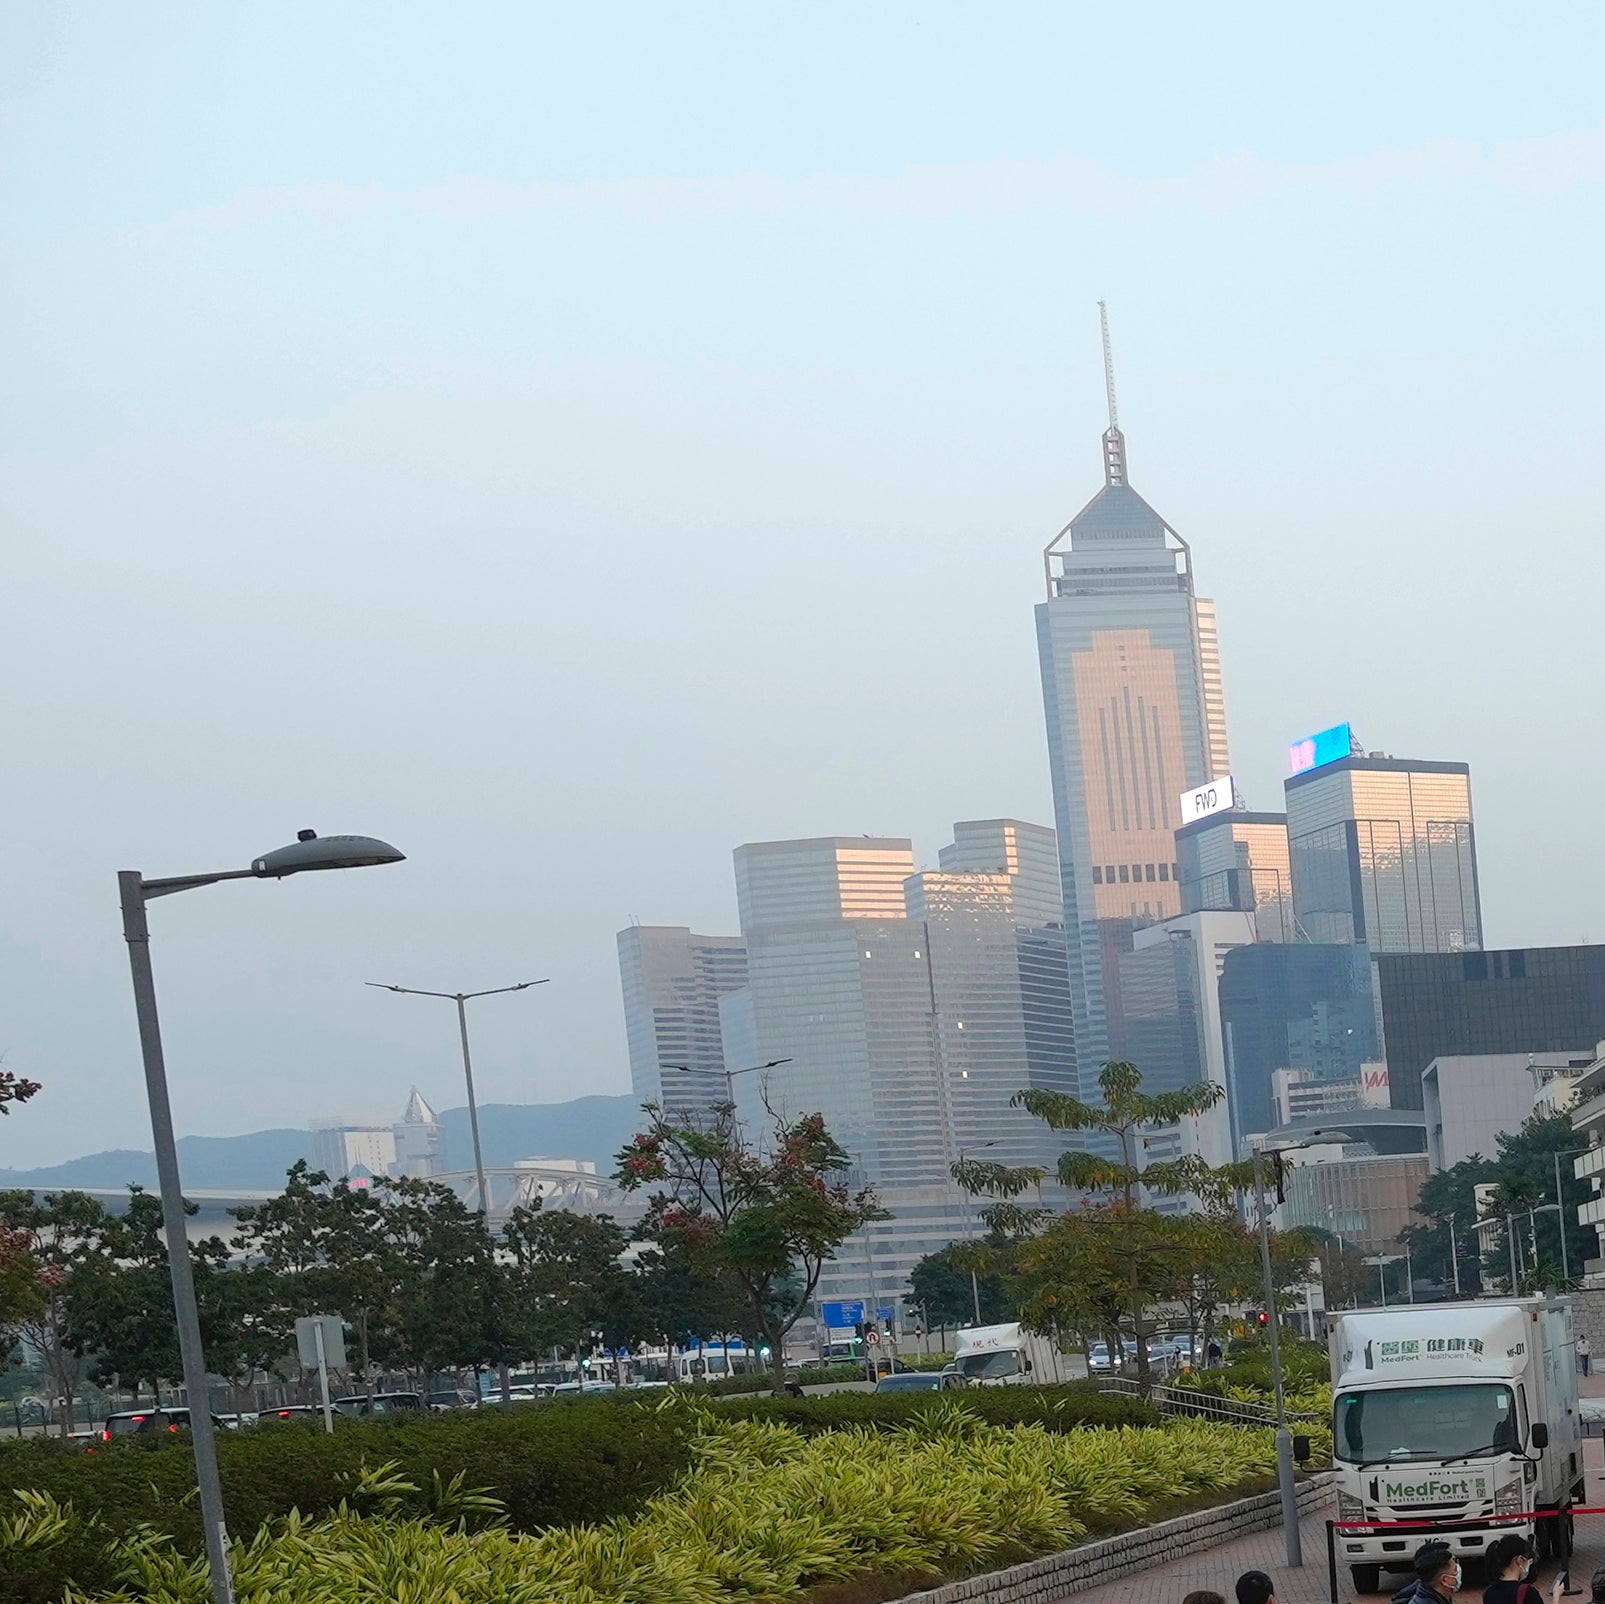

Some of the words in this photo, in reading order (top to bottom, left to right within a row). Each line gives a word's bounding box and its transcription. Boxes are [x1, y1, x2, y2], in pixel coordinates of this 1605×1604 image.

[1195, 788, 1218, 813] FWD
[1381, 1353, 1420, 1364] MedFort
[1426, 1352, 1466, 1361] Healthcare
[1385, 1479, 1469, 1498] MedFort
[1386, 1496, 1435, 1504] Healthcare
[1438, 1493, 1470, 1501] Limited
